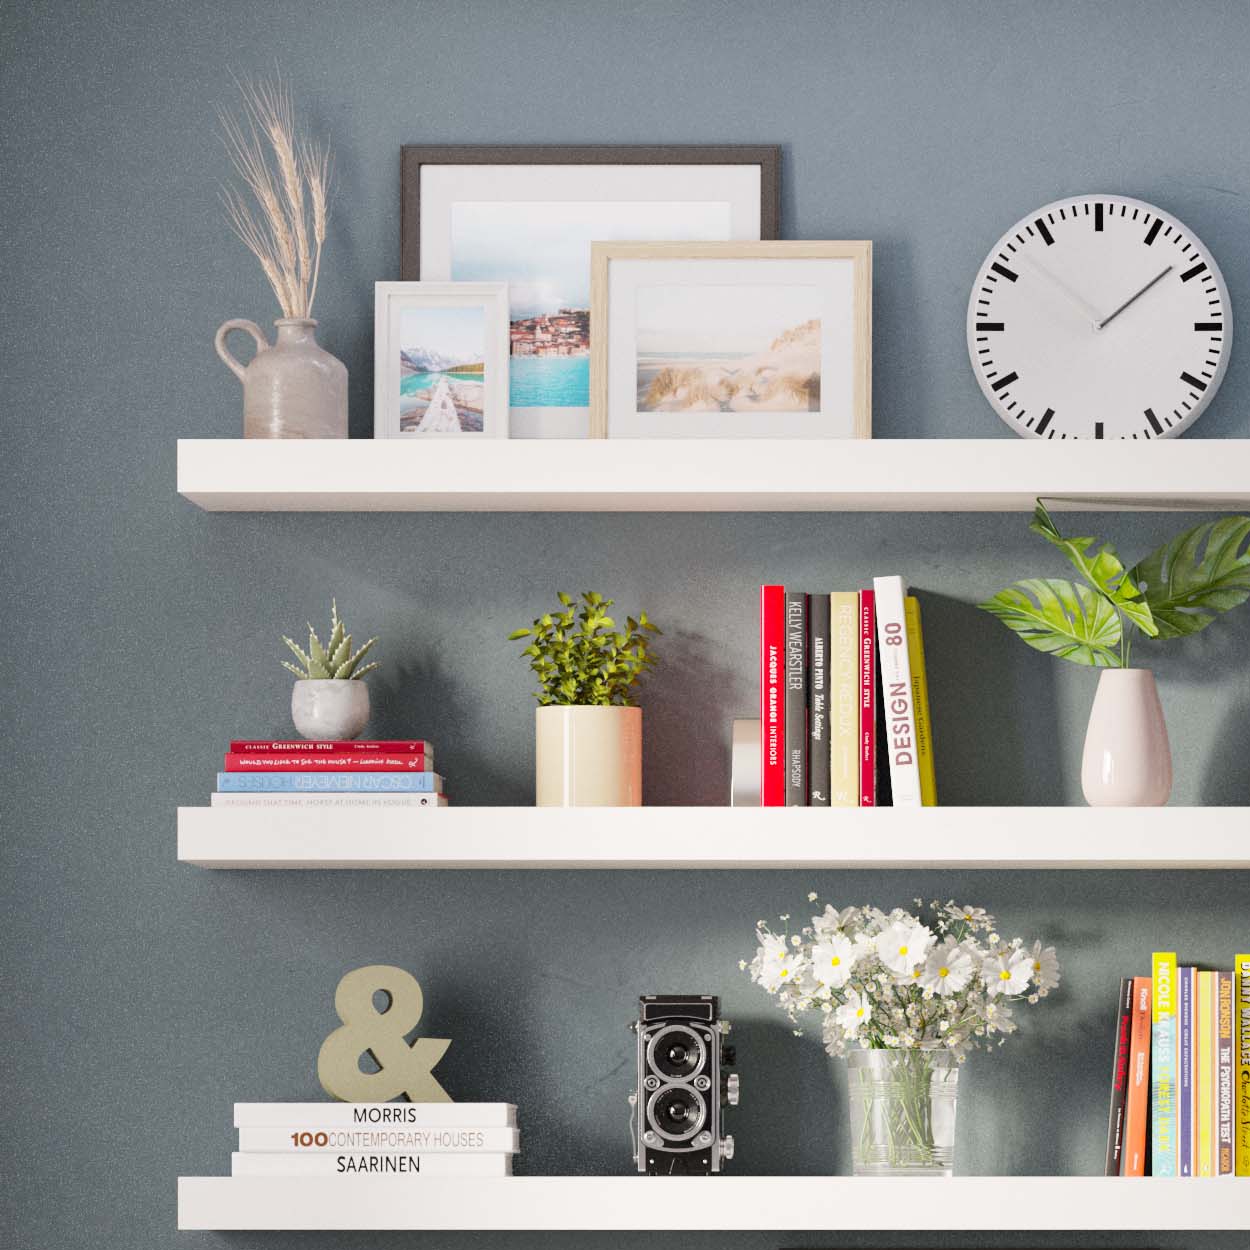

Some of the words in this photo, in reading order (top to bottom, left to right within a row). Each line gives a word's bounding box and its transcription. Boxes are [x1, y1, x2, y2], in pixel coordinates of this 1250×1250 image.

[788, 601, 803, 629] KELLY
[884, 622, 903, 646] 80
[769, 645, 777, 684] JACQUES
[788, 631, 803, 689] WEARSTLER
[815, 637, 824, 667] ALBERTO
[863, 637, 872, 685] GREENWICH
[815, 668, 824, 689] PINTO
[814, 693, 824, 712] Table
[863, 688, 871, 708] STYLE
[812, 713, 825, 740] Settings
[889, 682, 913, 766] DESIGN
[769, 726, 777, 767] INTERIORS
[791, 749, 801, 788] RHAPSODY
[1158, 962, 1170, 1008] NICOLE
[1220, 978, 1231, 998] JON
[1220, 999, 1231, 1039] RONSON
[1158, 1012, 1170, 1062] KRAUSS
[1220, 1047, 1231, 1064] THE
[1158, 1066, 1170, 1112] FOREST
[1220, 1065, 1231, 1122] PSYCHOPATH
[353, 1108, 417, 1122] MORRIS
[434, 1132, 484, 1147] HOUSES
[1220, 1122, 1231, 1144] TEST
[337, 1156, 420, 1172] SAARINEN
